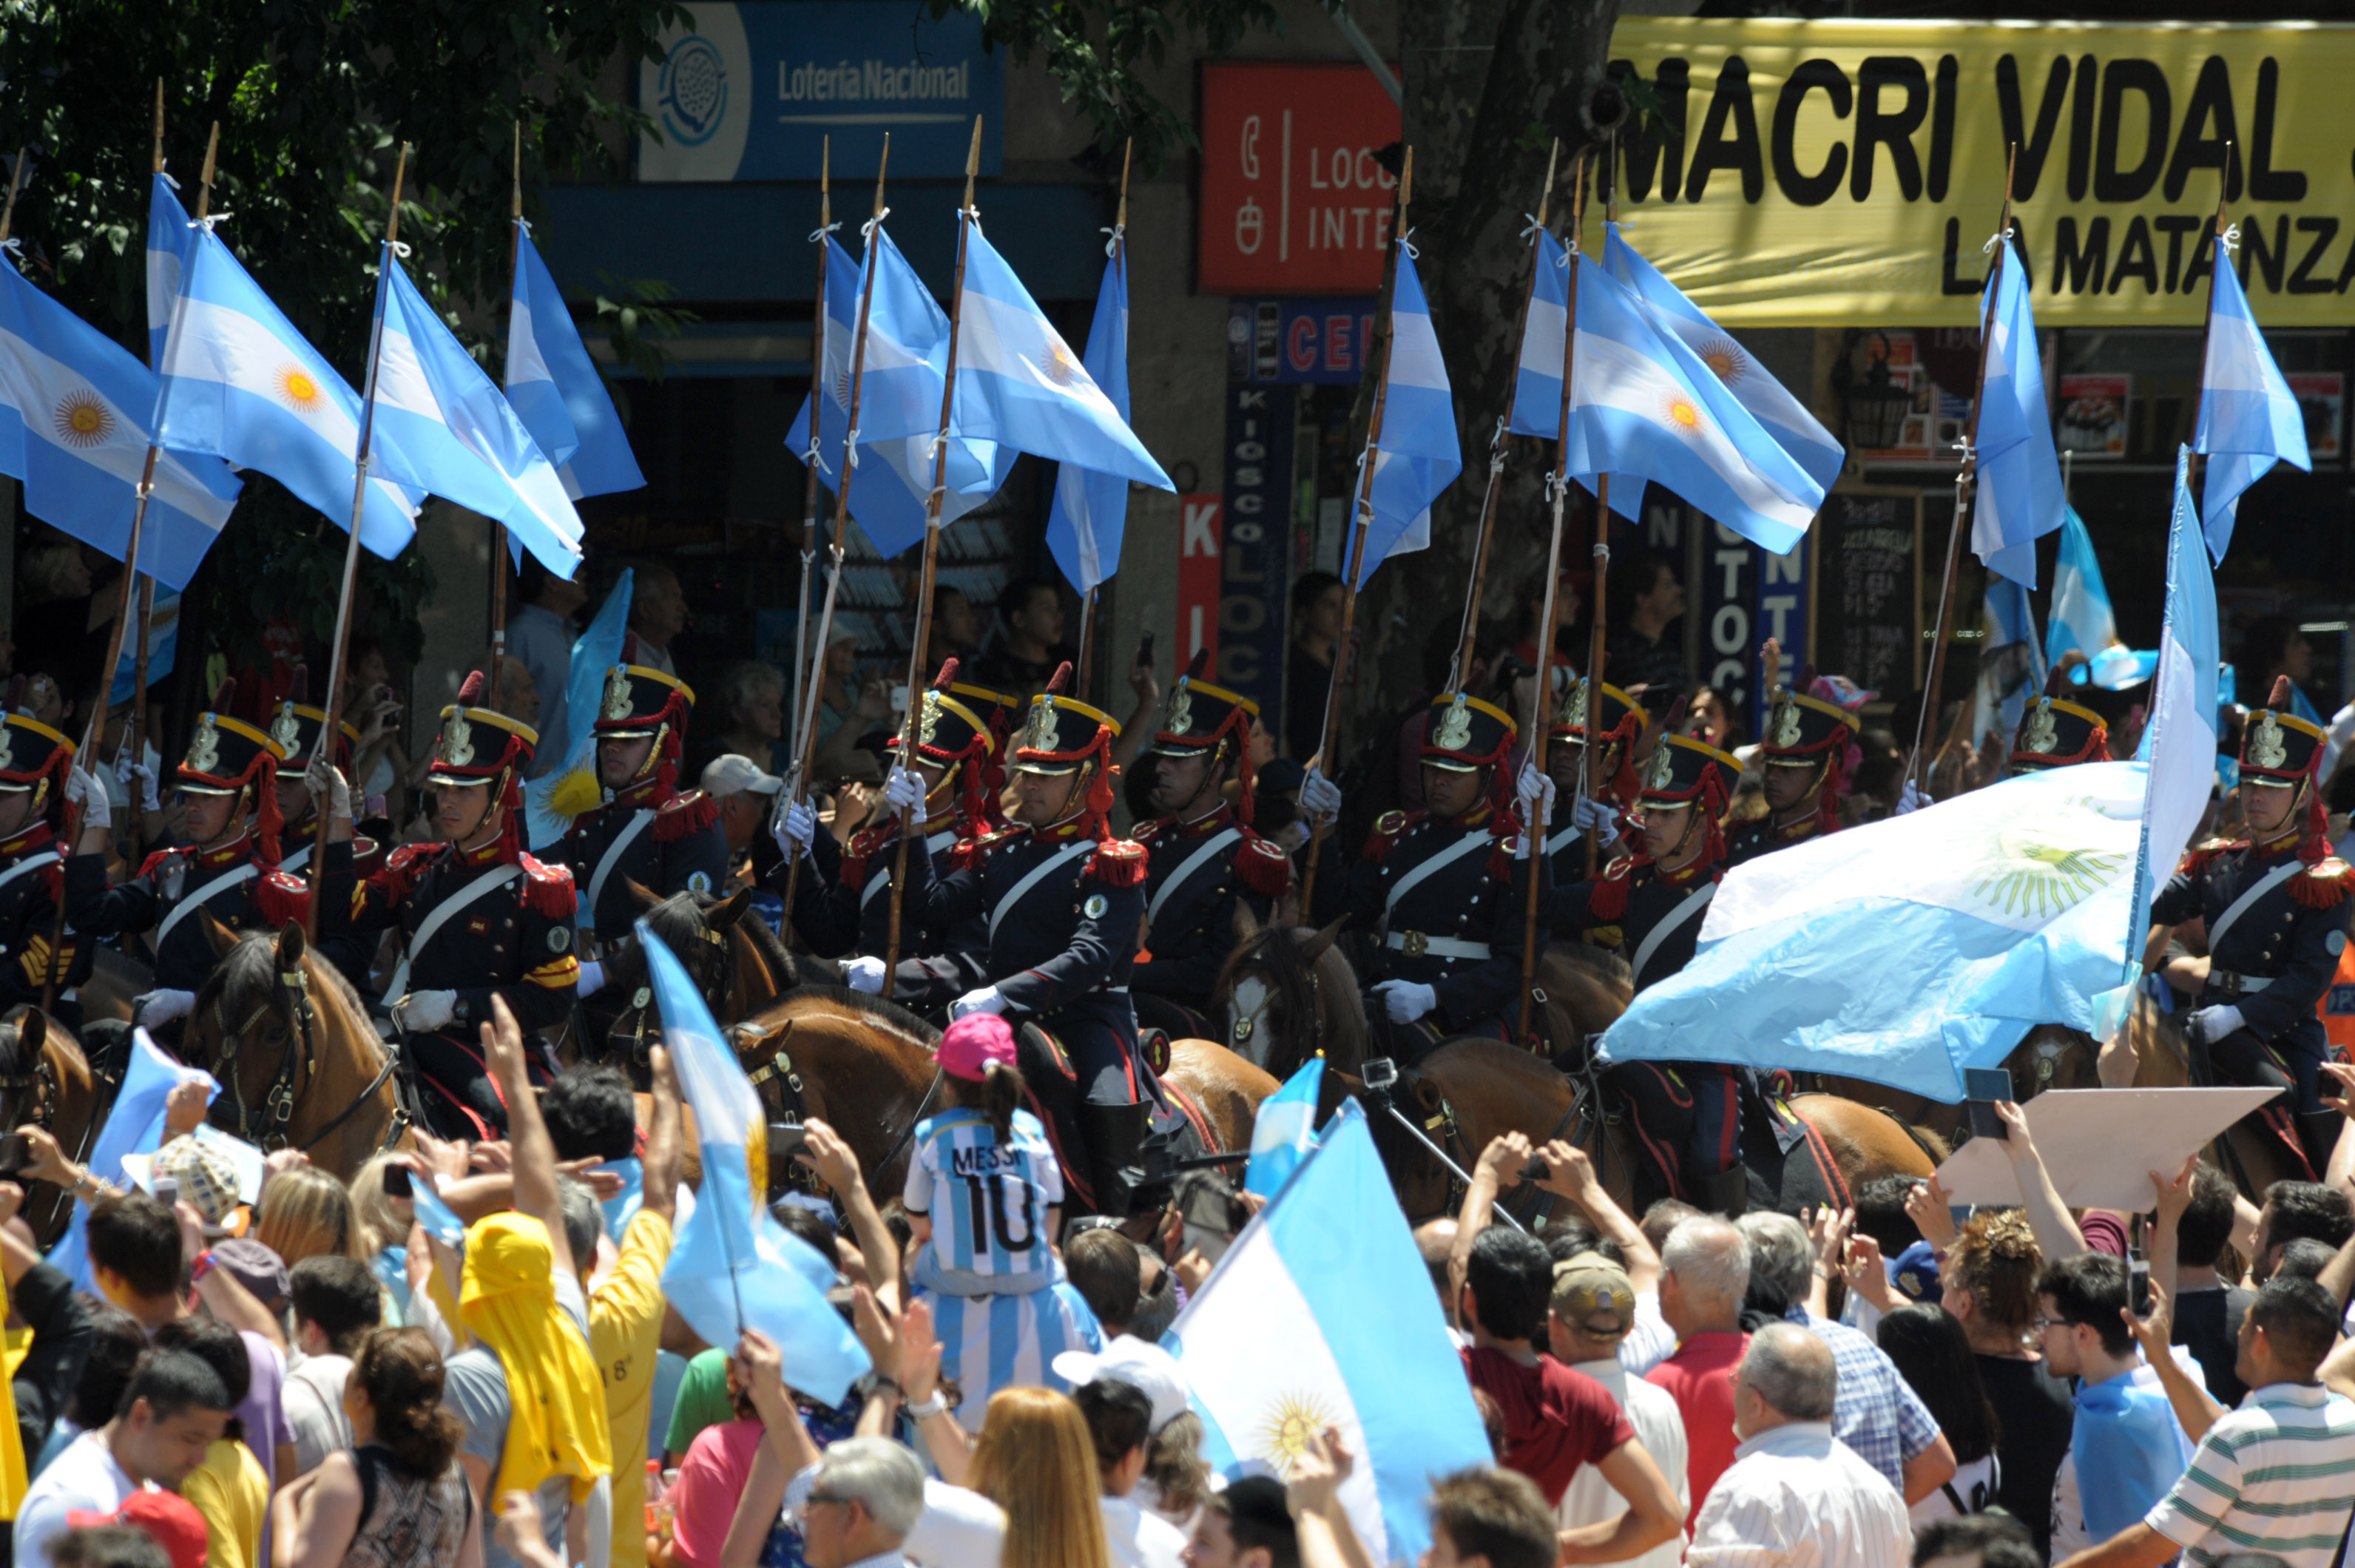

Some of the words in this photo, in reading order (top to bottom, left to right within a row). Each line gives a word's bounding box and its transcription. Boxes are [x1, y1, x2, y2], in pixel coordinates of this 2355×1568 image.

[778, 58, 862, 101] Lotería
[863, 58, 969, 101] Nacional
[1596, 54, 1958, 206] MACRI
[1996, 54, 2307, 203] VIDAL
[1231, 391, 1266, 543] KIOSCO
[952, 1146, 1021, 1177] MESSI
[966, 1174, 1036, 1254] 10
